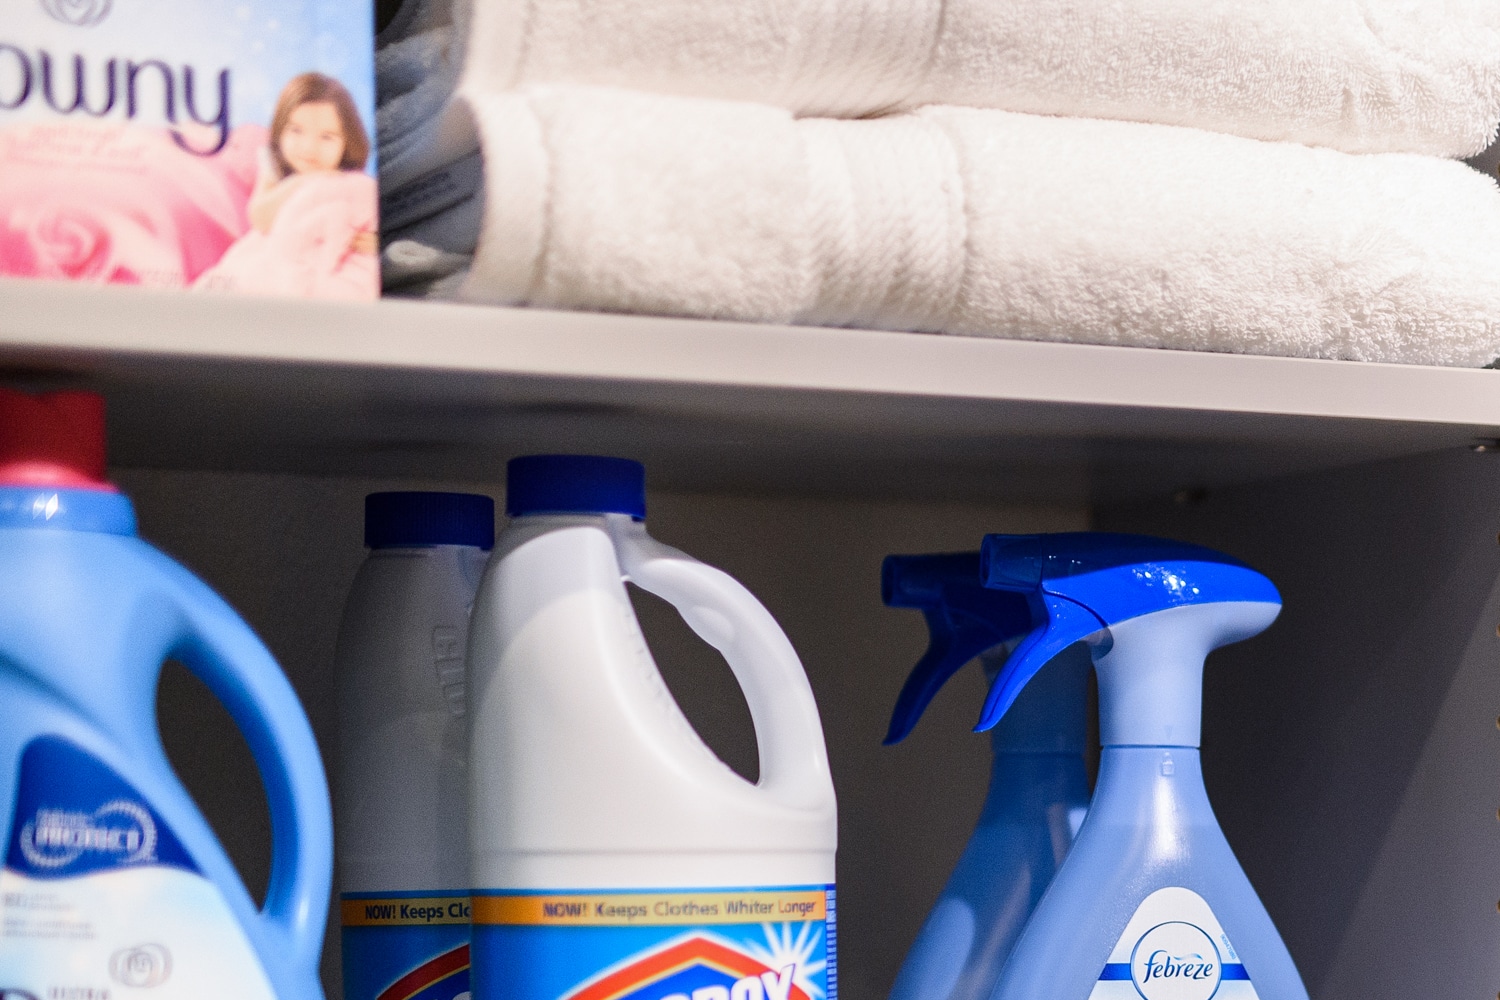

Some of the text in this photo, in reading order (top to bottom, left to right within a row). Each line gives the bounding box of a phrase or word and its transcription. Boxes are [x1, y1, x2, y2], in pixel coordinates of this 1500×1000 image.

[364, 904, 396, 919] NOW!
[400, 903, 444, 922] Keeps
[542, 898, 817, 921] NOW! Keeps Clothes Whiter Longer
[1142, 949, 1214, 984] febreze
